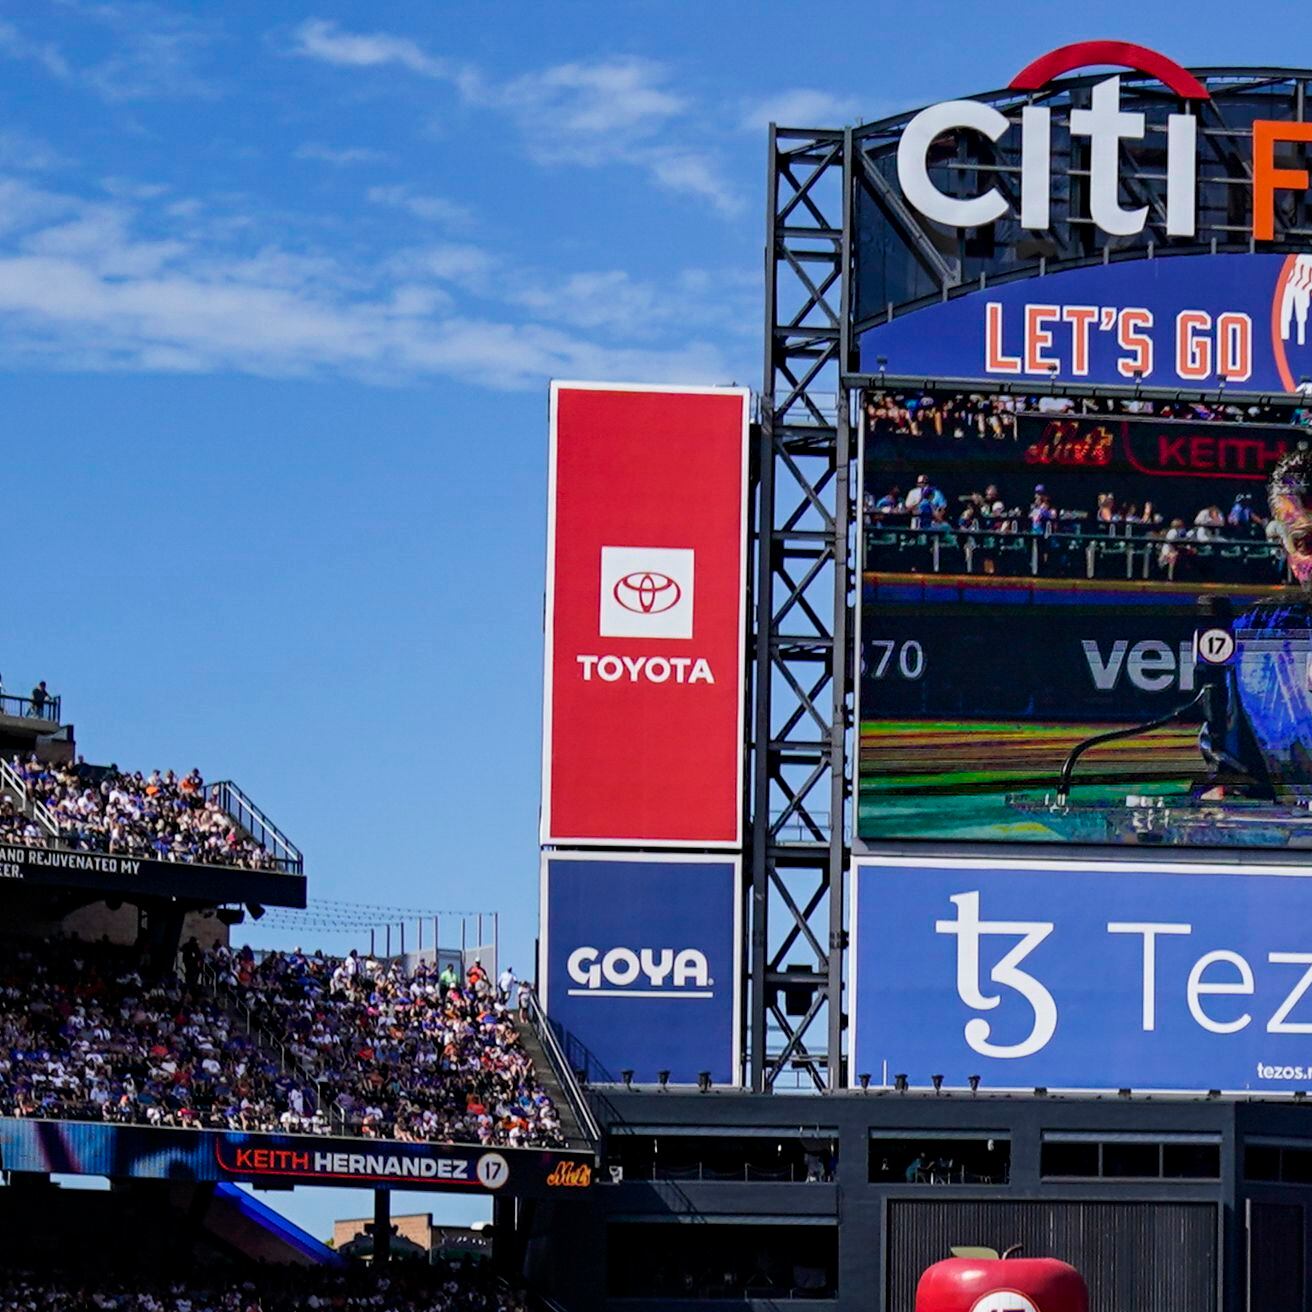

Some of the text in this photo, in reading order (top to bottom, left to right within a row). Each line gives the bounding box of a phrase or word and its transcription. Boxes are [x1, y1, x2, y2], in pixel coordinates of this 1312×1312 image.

[897, 75, 1195, 237] citi
[986, 302, 1252, 382] LET'S GO
[1157, 434, 1288, 470] KEITH
[577, 654, 715, 684] TOYOTA
[28, 850, 118, 873] REJUVENATED
[121, 860, 141, 875] MY
[567, 946, 708, 990] GOYA
[234, 1148, 592, 1189] KEITH HERNANDEZ 17 Mets
